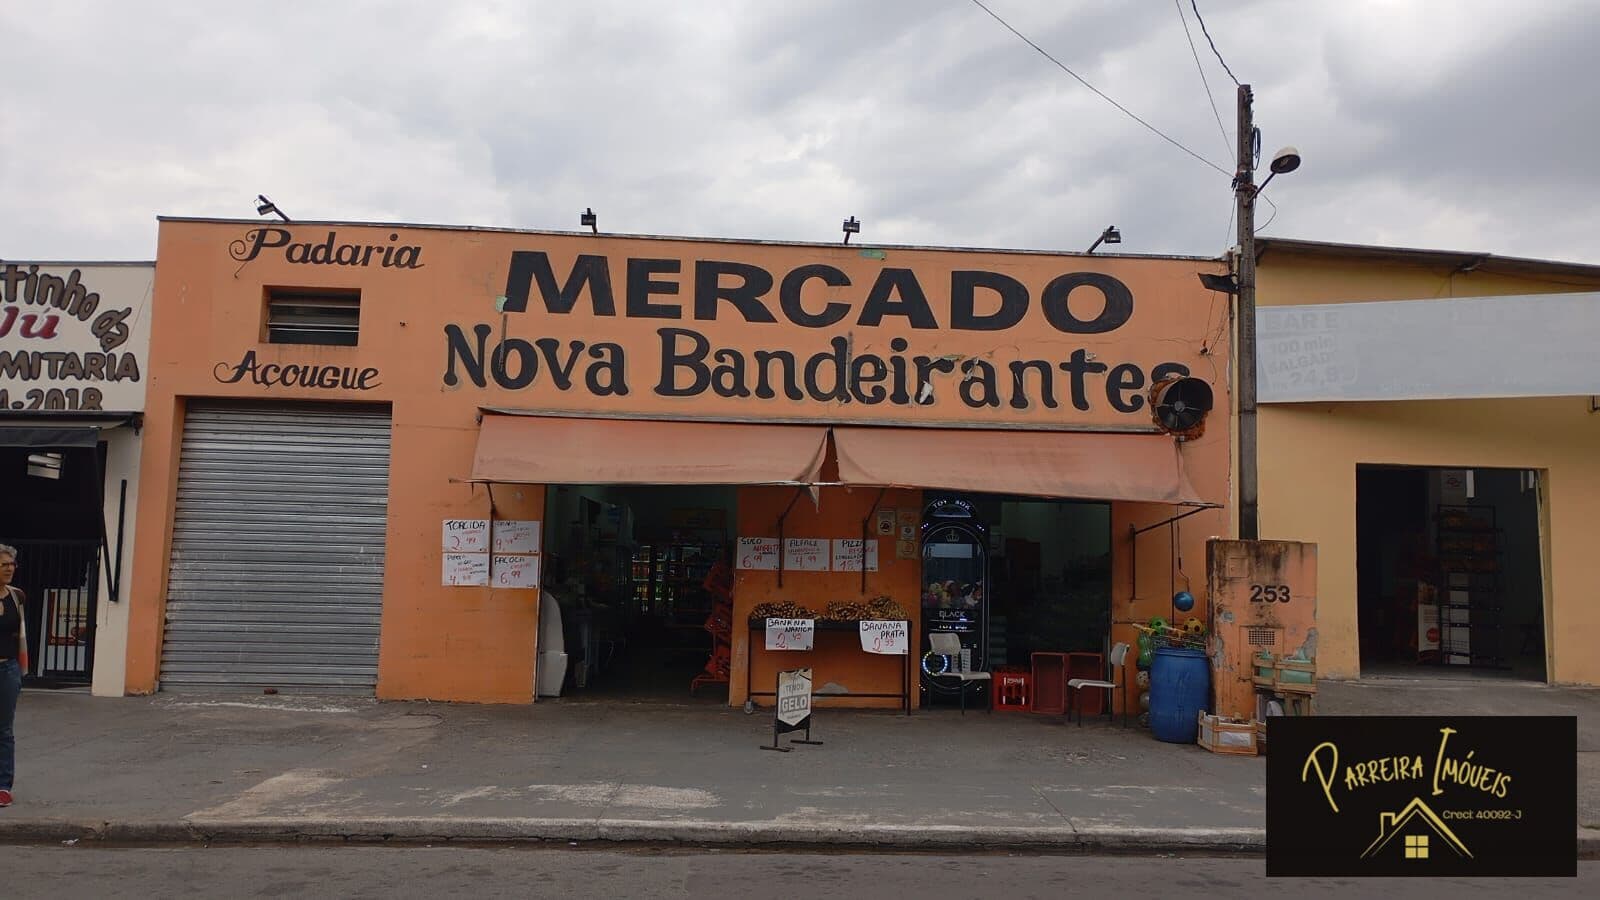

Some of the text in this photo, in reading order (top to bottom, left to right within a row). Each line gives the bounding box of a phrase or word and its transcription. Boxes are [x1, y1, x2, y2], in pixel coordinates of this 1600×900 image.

[229, 228, 424, 278] Padaria
[504, 250, 1134, 334] MERCADO
[443, 323, 628, 396] Nova
[445, 520, 486, 531] TORCIDA
[1249, 585, 1291, 604] 253
[767, 618, 807, 627] BANANA
[862, 621, 902, 631] BANANA
[880, 630, 905, 639] PRATA
[782, 697, 808, 712] GELO
